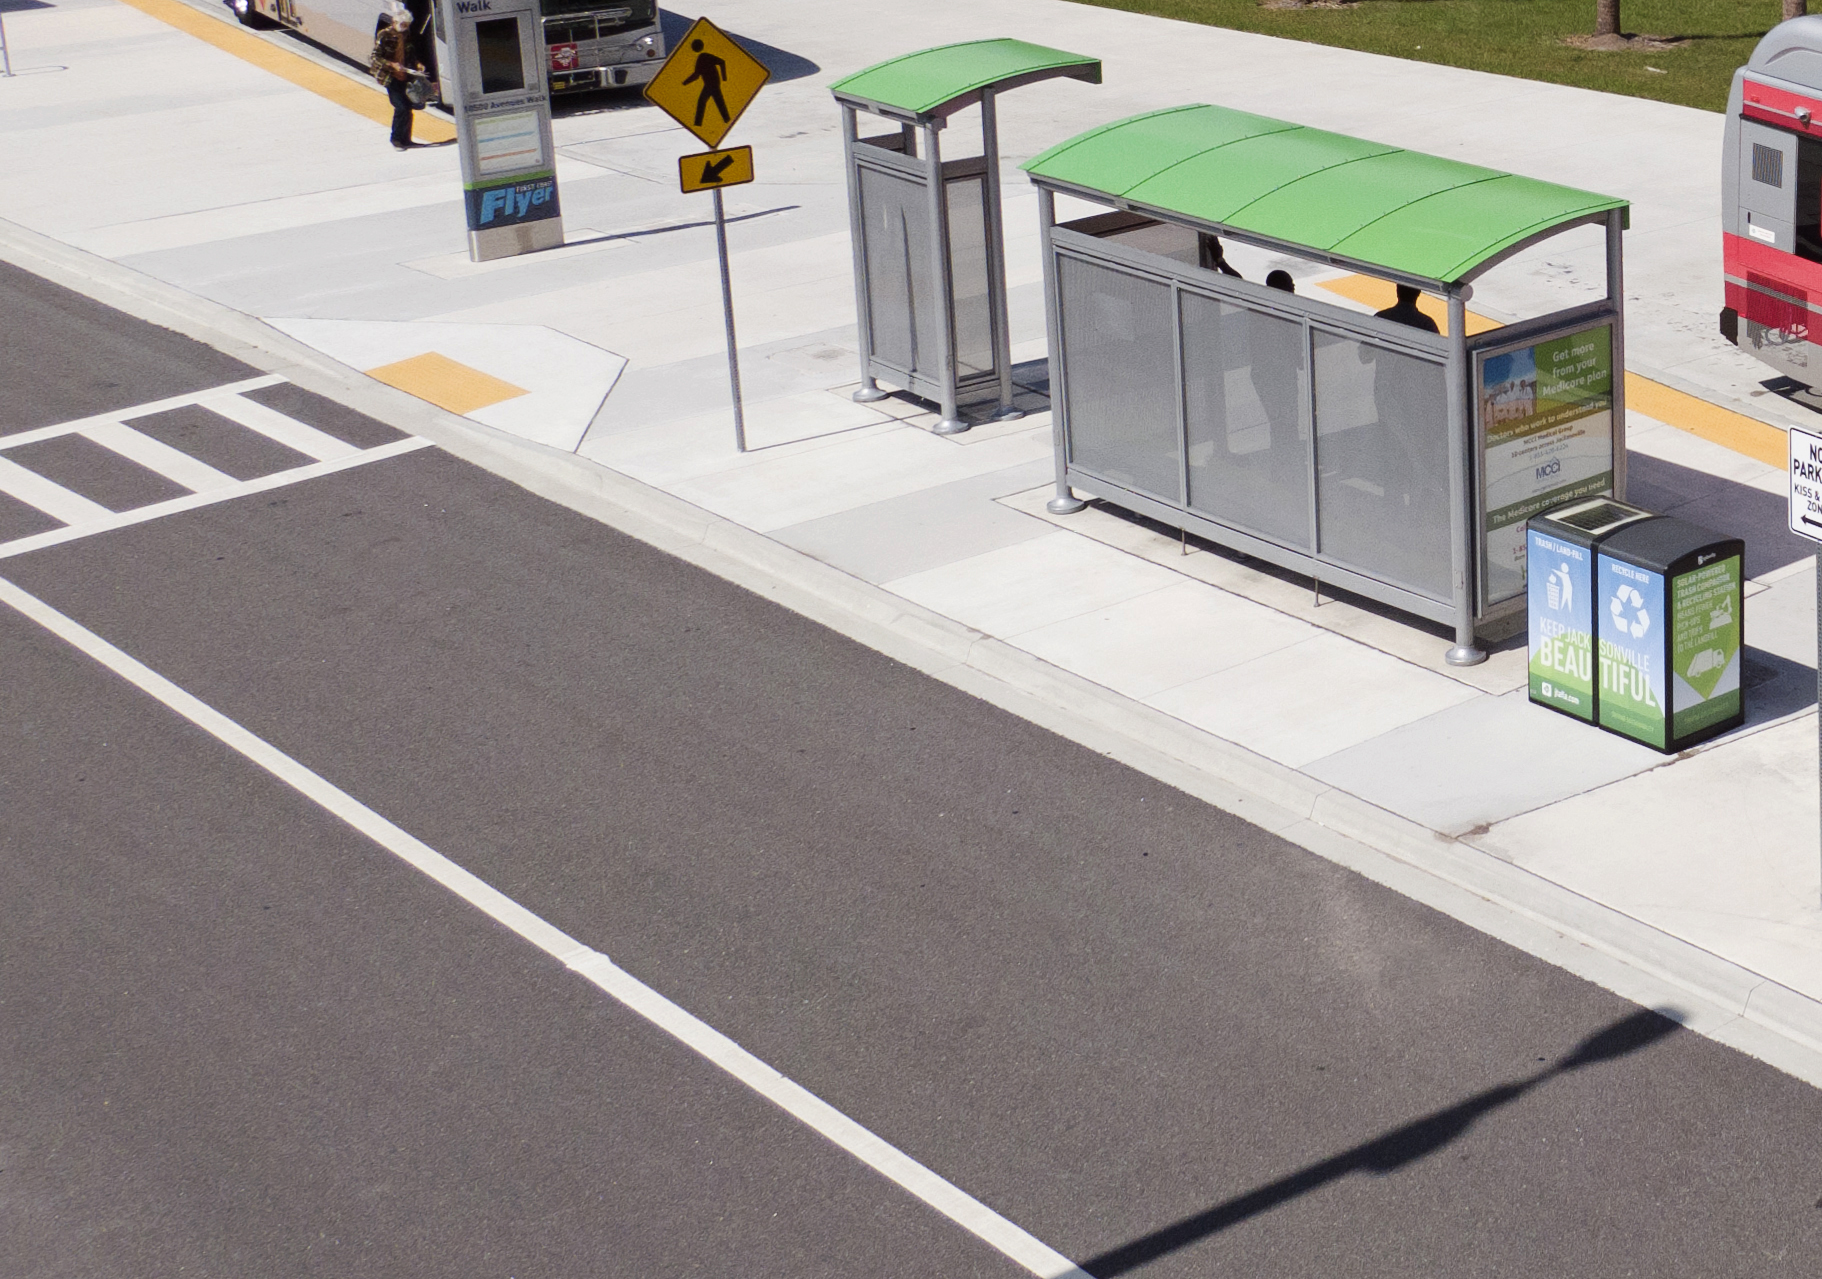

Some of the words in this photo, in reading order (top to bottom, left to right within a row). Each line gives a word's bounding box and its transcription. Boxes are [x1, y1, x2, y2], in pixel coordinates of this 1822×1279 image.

[456, 0, 492, 14] Walk
[490, 99, 525, 110] Avenues
[526, 95, 546, 104] Walk
[515, 183, 536, 193] FIRST
[480, 185, 554, 225] Flyer
[1552, 350, 1570, 363] Get
[1571, 342, 1594, 358] more
[1552, 365, 1574, 379] from
[1576, 357, 1596, 374] your
[1542, 377, 1585, 396] Medicare
[1587, 368, 1607, 384] plan
[1530, 417, 1547, 429] work
[1548, 415, 1556, 423] to
[1493, 514, 1506, 524] The
[1507, 501, 1541, 518] Medicare
[1541, 491, 1574, 507] coverage
[1574, 486, 1588, 498] you
[1588, 477, 1606, 492] need
[1794, 482, 1812, 499] KISS
[1814, 490, 1820, 502] &
[1534, 536, 1552, 551] TRASH
[1611, 563, 1634, 579] RECYCLE
[1635, 572, 1650, 585] HERE
[1540, 616, 1565, 639] KEEP
[1565, 627, 1591, 651] JACK
[1599, 638, 1650, 672] SONVILLE
[1540, 635, 1592, 682] BEAU
[1599, 656, 1656, 707] TIFUL
